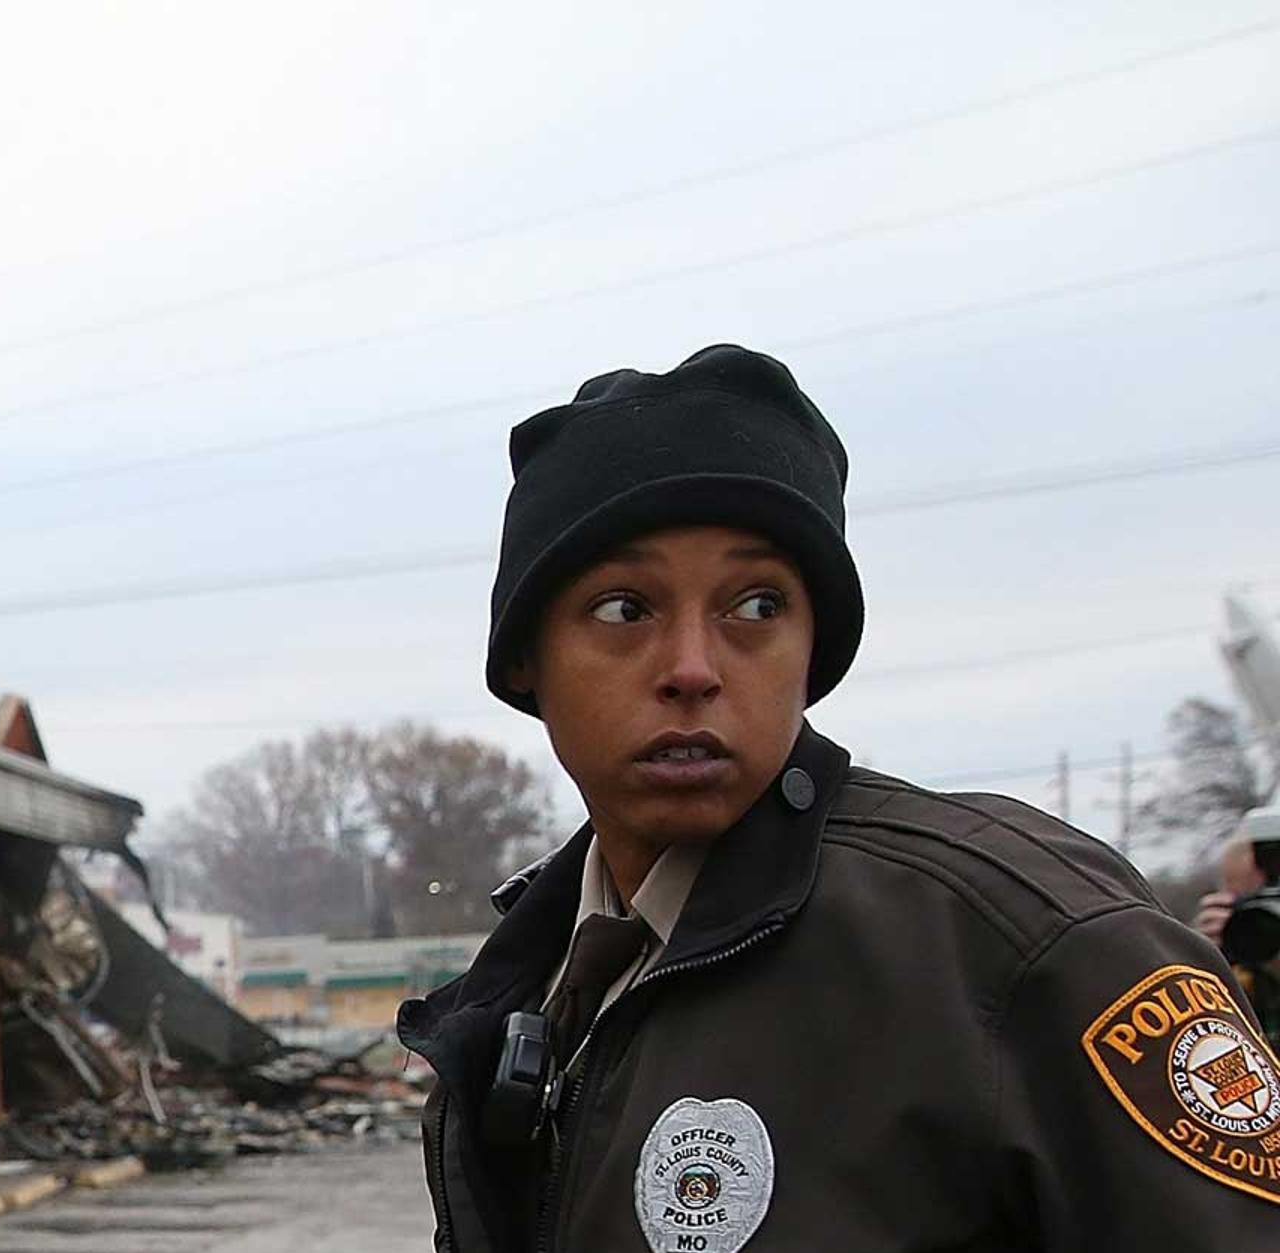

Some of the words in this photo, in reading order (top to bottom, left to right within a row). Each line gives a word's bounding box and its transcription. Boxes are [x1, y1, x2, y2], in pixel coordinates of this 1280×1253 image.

[1102, 977, 1234, 1064] POLICE
[1173, 1030, 1199, 1068] SERVE
[1211, 1113, 1251, 1132] LOUIS
[671, 1128, 736, 1147] OFFICER
[668, 1146, 702, 1166] LOUIS
[706, 1147, 749, 1177] COUNTY
[663, 1206, 728, 1226] POLICE
[677, 1235, 708, 1251] MO
